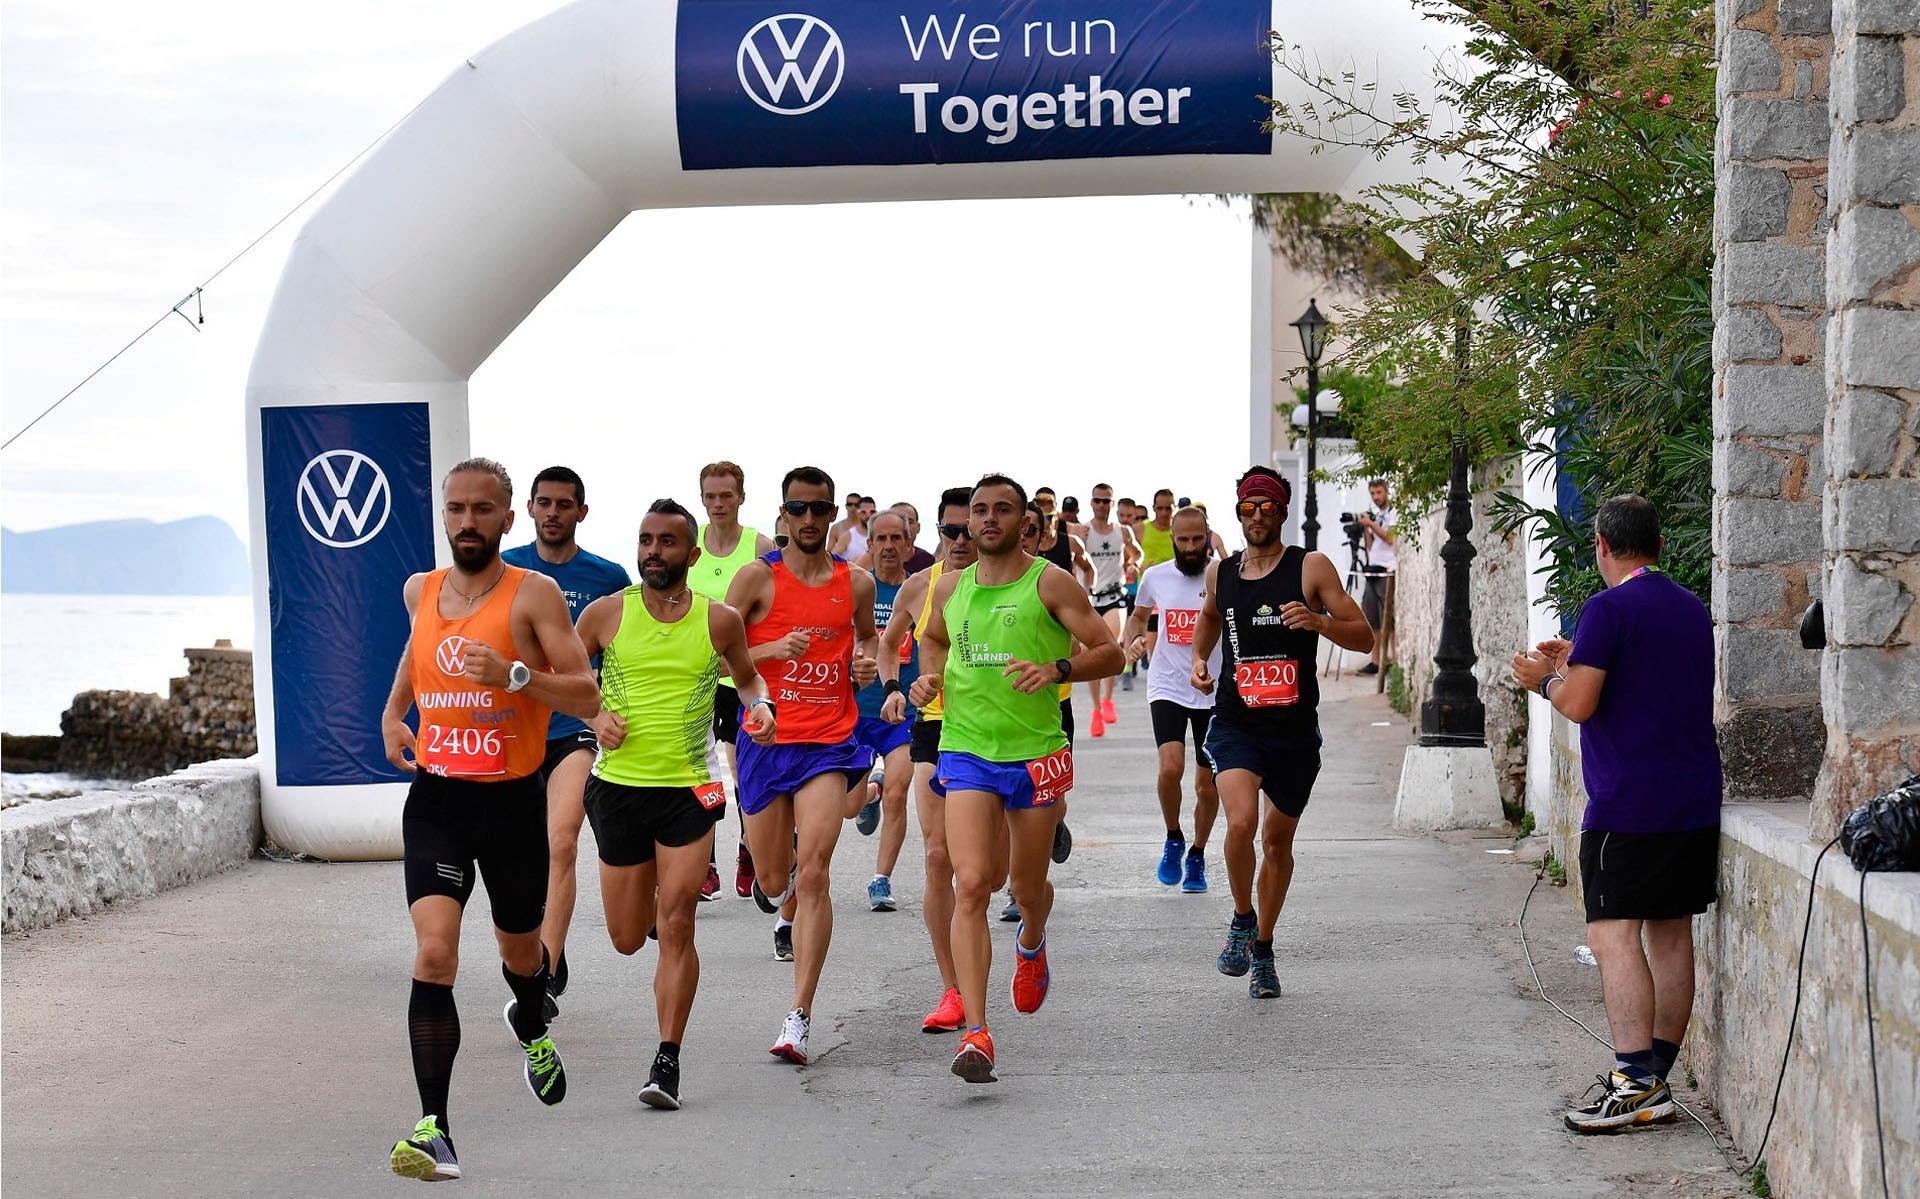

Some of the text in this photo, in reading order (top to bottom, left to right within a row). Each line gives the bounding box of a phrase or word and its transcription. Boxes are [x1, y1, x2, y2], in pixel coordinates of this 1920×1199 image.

[900, 13, 1116, 61] We run
[899, 76, 1191, 145] Together
[1252, 615, 1280, 626] PROTEIN
[1169, 633, 1181, 643] 25K
[971, 643, 989, 652] IT'S
[783, 660, 839, 685] 2293
[1240, 664, 1296, 688] 2420
[420, 690, 493, 709] RUNNING
[779, 689, 800, 702] 25K
[471, 708, 516, 725] team
[427, 724, 501, 756] 2406
[702, 789, 723, 807] 25K
[1035, 787, 1055, 801] 25K
